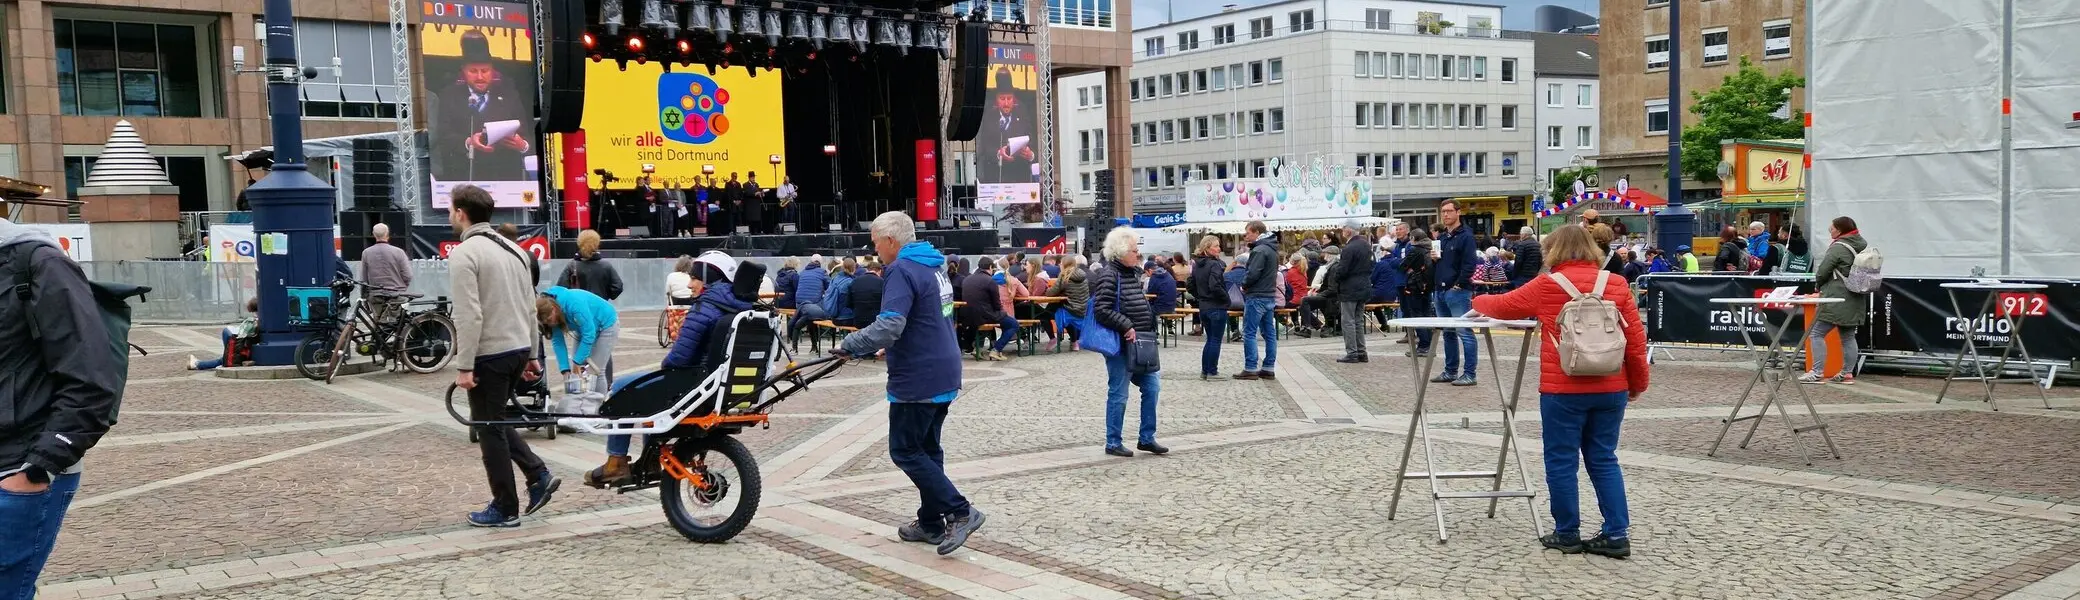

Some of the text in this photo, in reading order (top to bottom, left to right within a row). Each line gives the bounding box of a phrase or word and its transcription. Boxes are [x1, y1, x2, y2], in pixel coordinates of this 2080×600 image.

[611, 131, 663, 147] wir alle
[637, 149, 729, 161] sind Dortmund
[1154, 214, 1174, 225] Genie
[2004, 296, 2044, 315] 91.2
[1710, 306, 1767, 325] radio
[1946, 313, 2010, 334] radio
[1728, 325, 1766, 333] DORMUND
